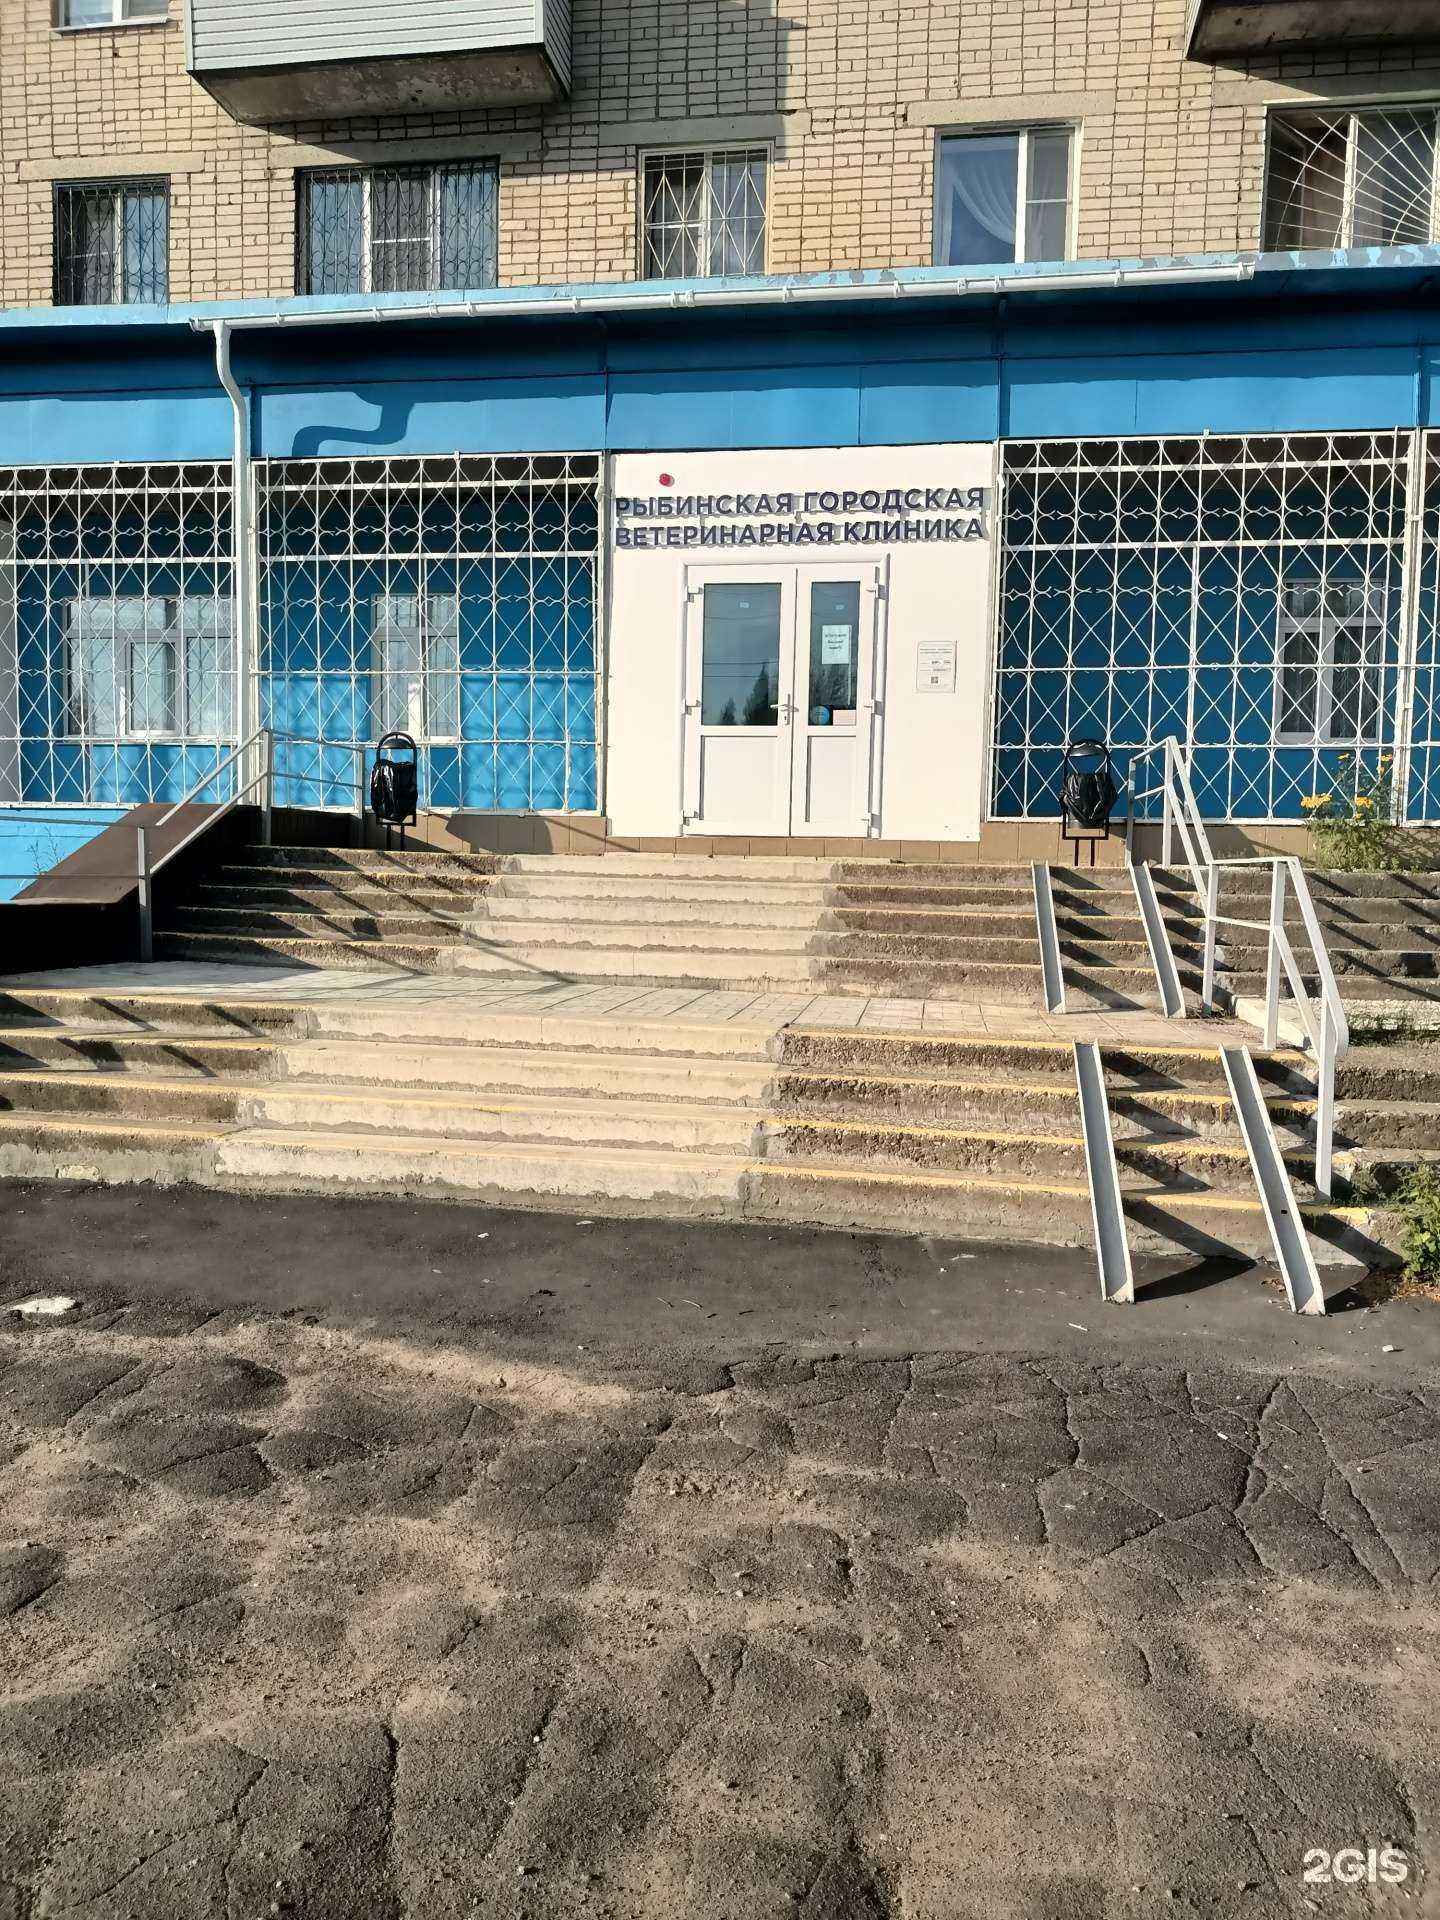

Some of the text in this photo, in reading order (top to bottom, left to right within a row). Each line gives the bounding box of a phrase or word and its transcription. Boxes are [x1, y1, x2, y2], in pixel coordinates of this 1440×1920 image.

[616, 487, 984, 516] РЫБИНСКАЯ ГОРОДСКАЯ
[616, 518, 983, 546] ВЕТЕРИНАРНАЯ КЛИНИКА
